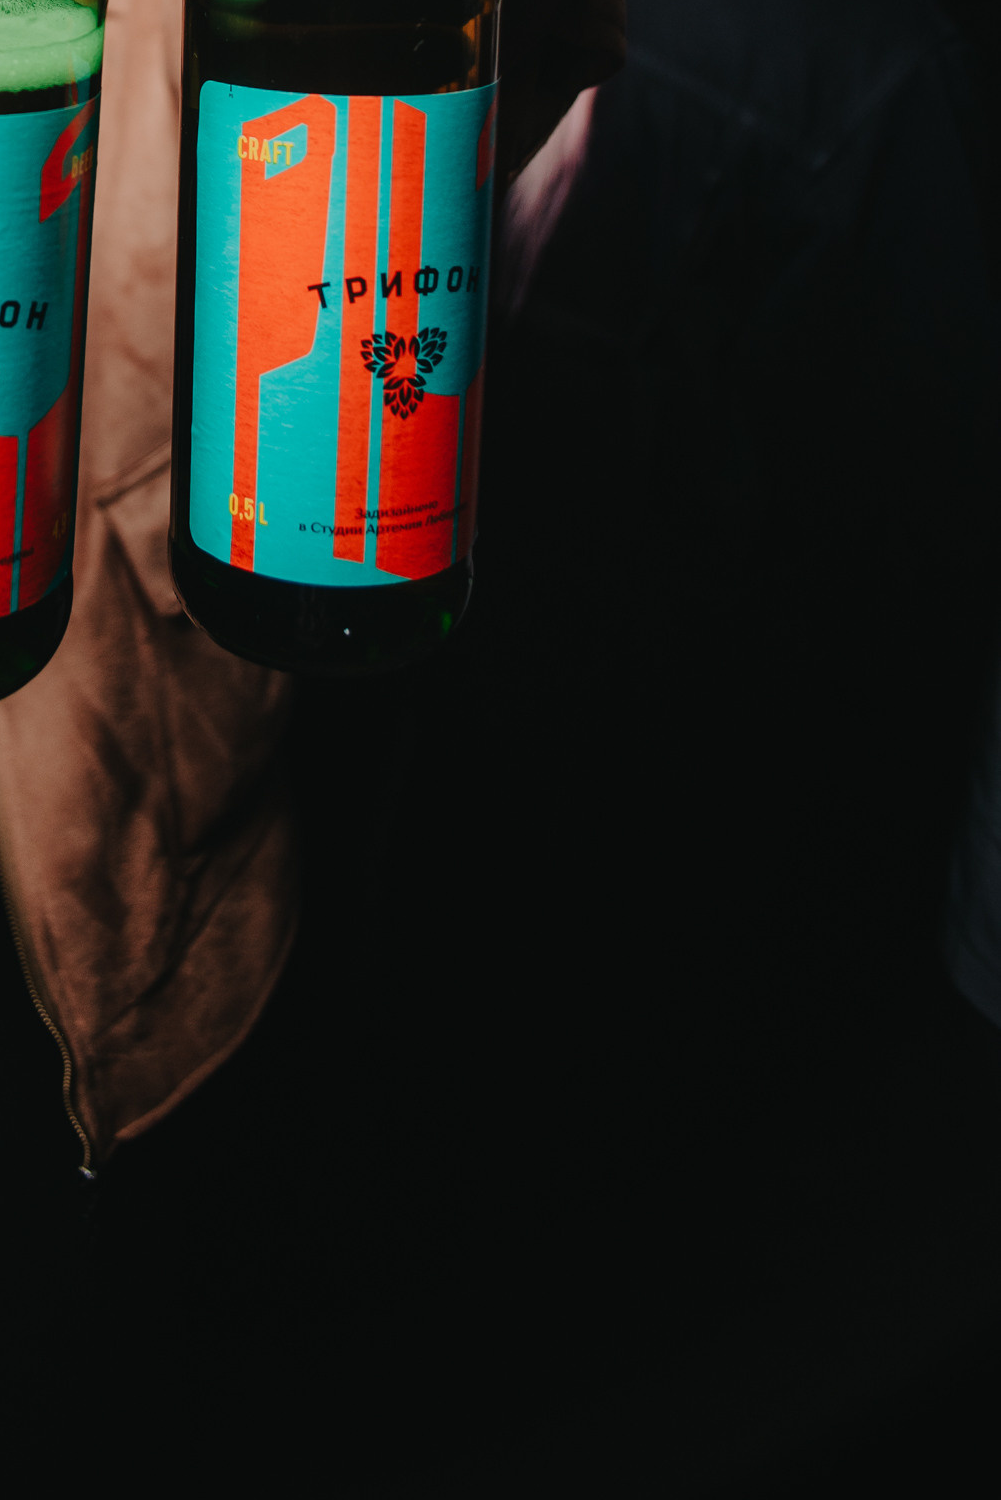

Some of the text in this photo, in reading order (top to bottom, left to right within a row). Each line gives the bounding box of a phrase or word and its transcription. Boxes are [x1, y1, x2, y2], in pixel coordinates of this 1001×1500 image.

[237, 135, 294, 166] CRAFT
[307, 265, 481, 309] ТРИФОН
[310, 521, 363, 538] Студии
